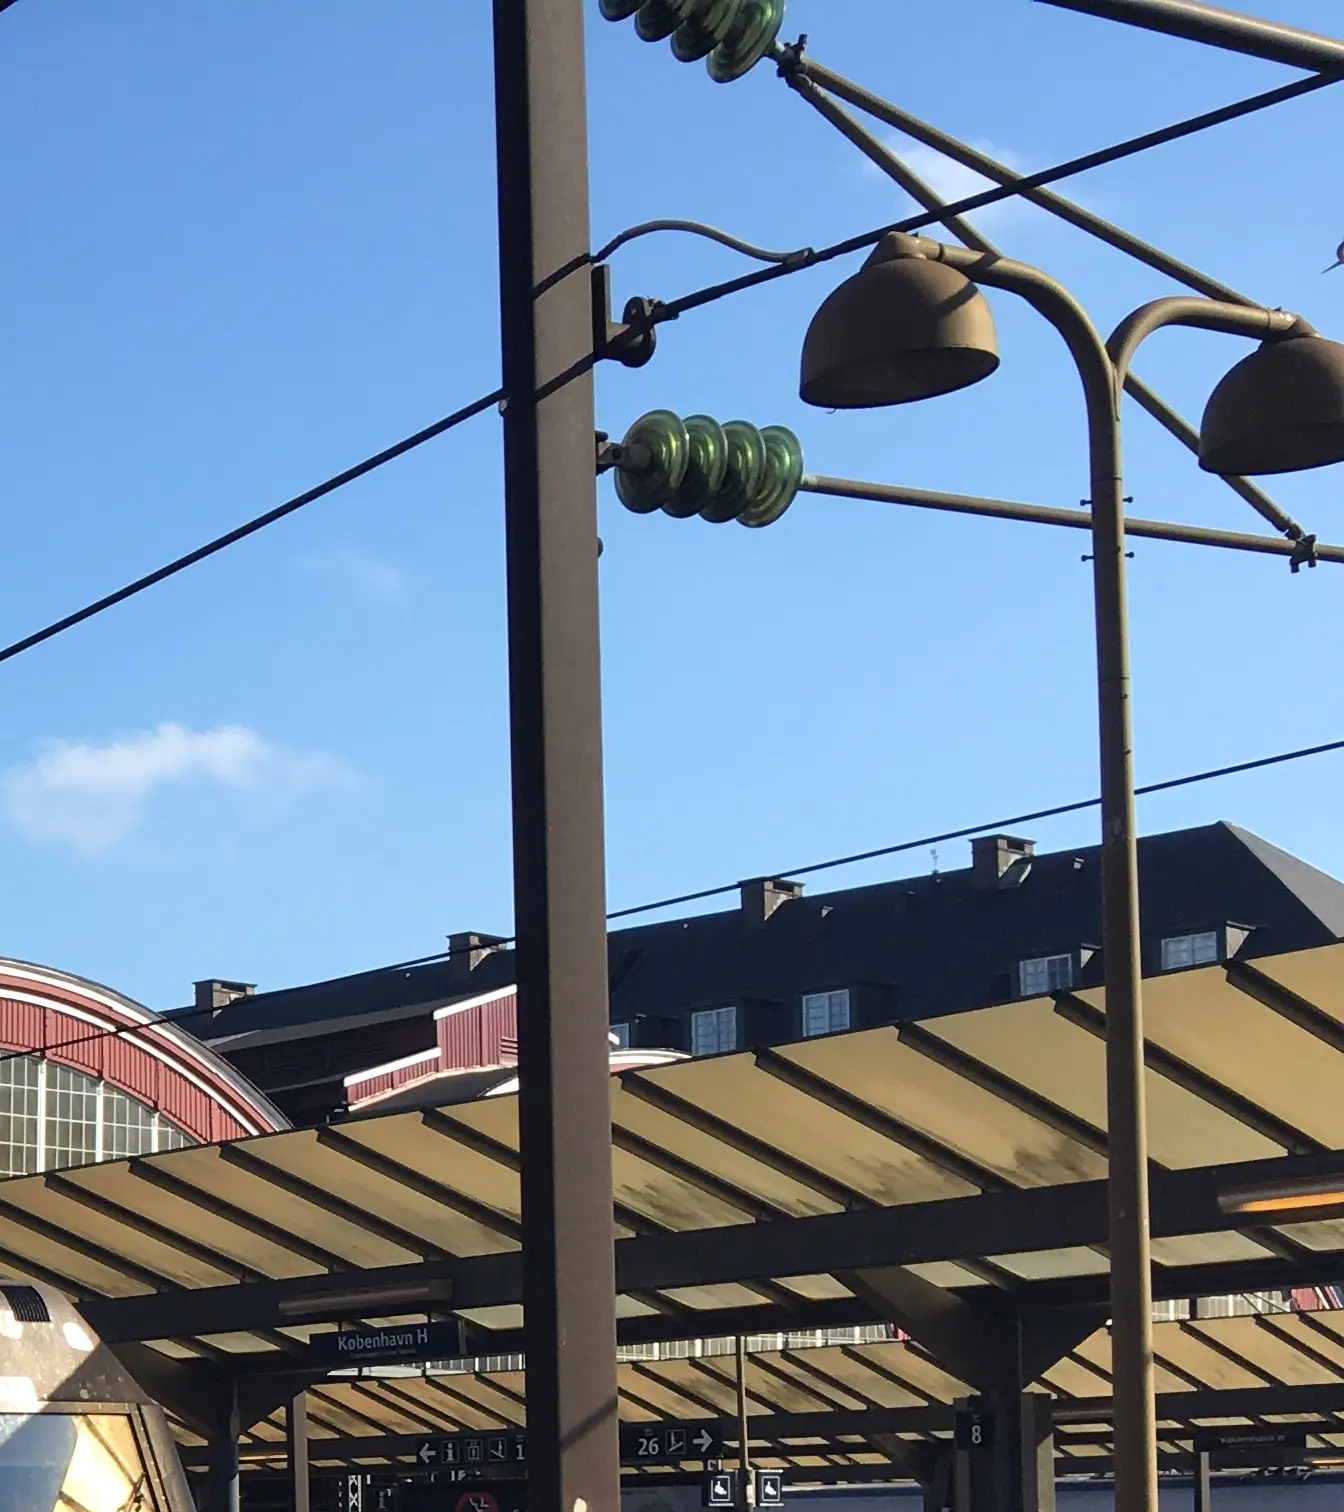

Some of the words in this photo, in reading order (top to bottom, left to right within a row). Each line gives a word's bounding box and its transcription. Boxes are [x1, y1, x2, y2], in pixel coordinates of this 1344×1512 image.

[338, 1332, 413, 1351] København
[417, 1328, 428, 1344] H
[971, 1424, 982, 1444] 8
[638, 1437, 659, 1456] 26
